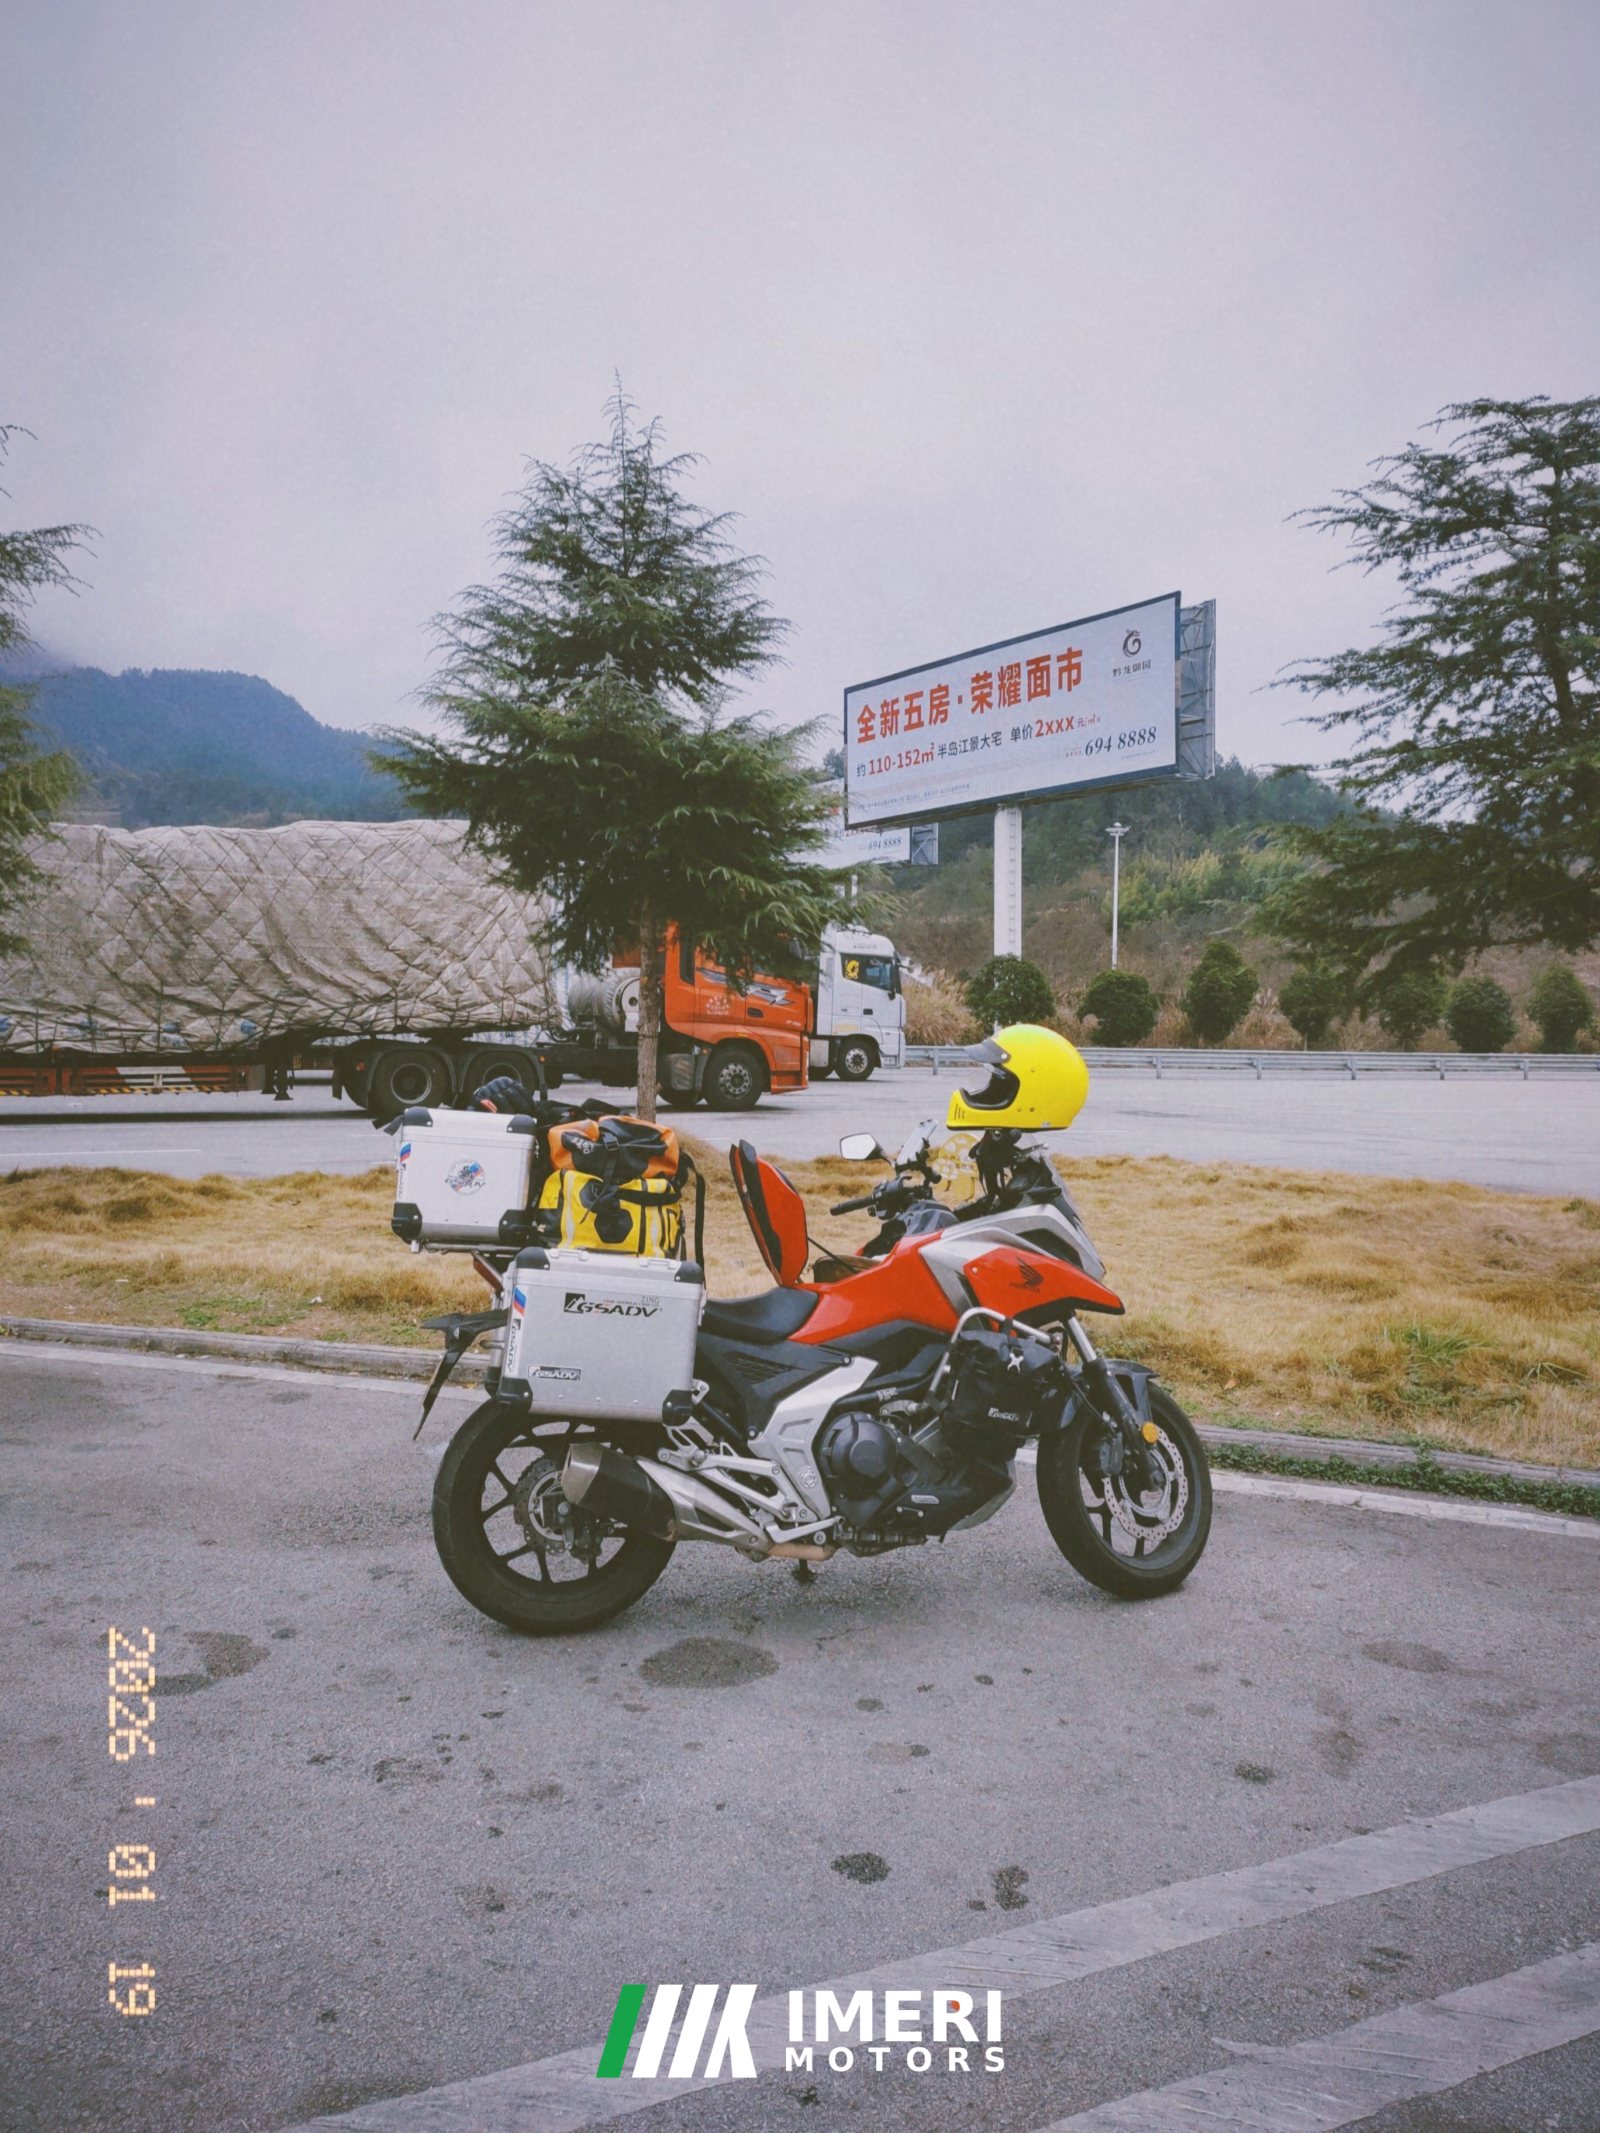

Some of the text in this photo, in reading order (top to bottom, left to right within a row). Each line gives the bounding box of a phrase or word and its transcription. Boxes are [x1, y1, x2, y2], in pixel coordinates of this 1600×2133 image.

[857, 647, 1083, 744] 全新五房·荣耀面市
[1085, 736, 1112, 756] 694
[1118, 726, 1157, 750] 8888
[577, 1301, 658, 1318] GSADV
